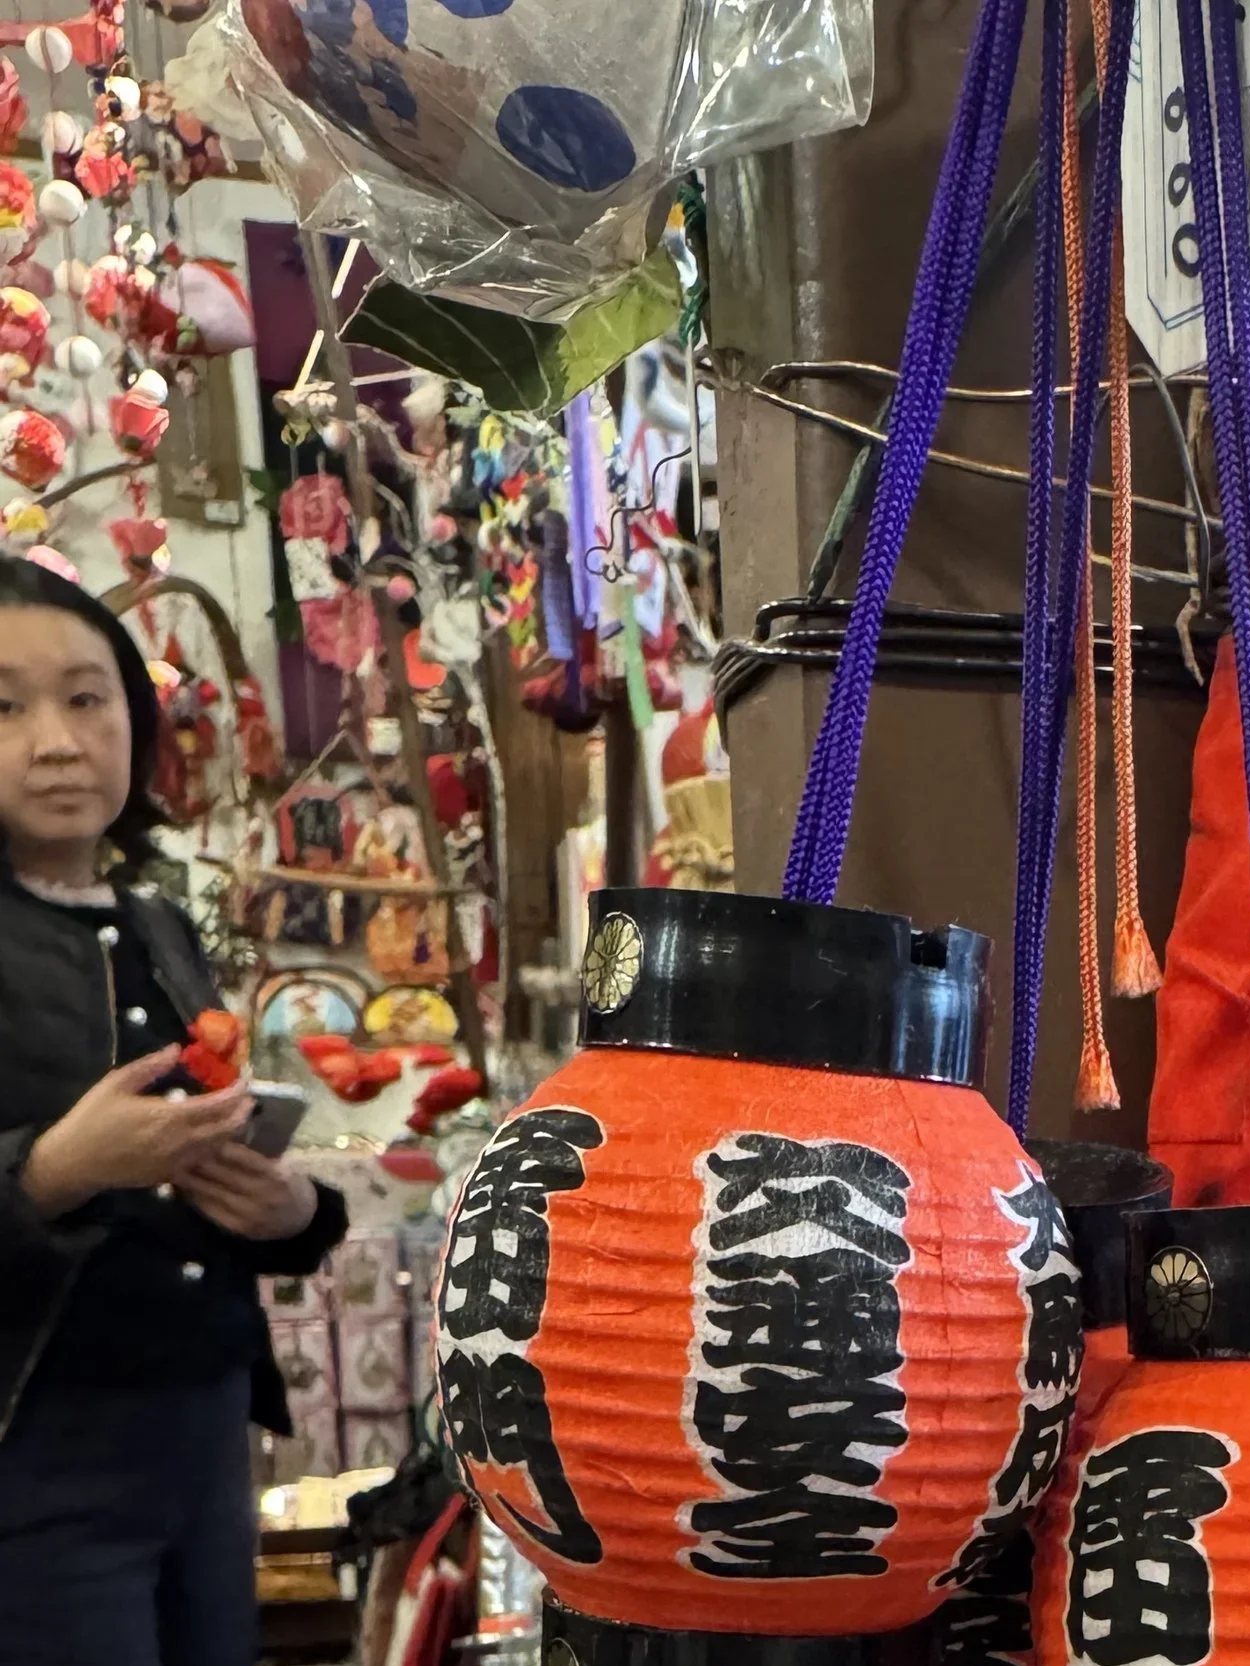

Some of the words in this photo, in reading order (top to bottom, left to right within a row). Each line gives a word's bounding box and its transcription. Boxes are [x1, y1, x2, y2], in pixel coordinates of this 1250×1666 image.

[438, 1108, 603, 1564] 雷門
[690, 1133, 911, 1578] 交通安全
